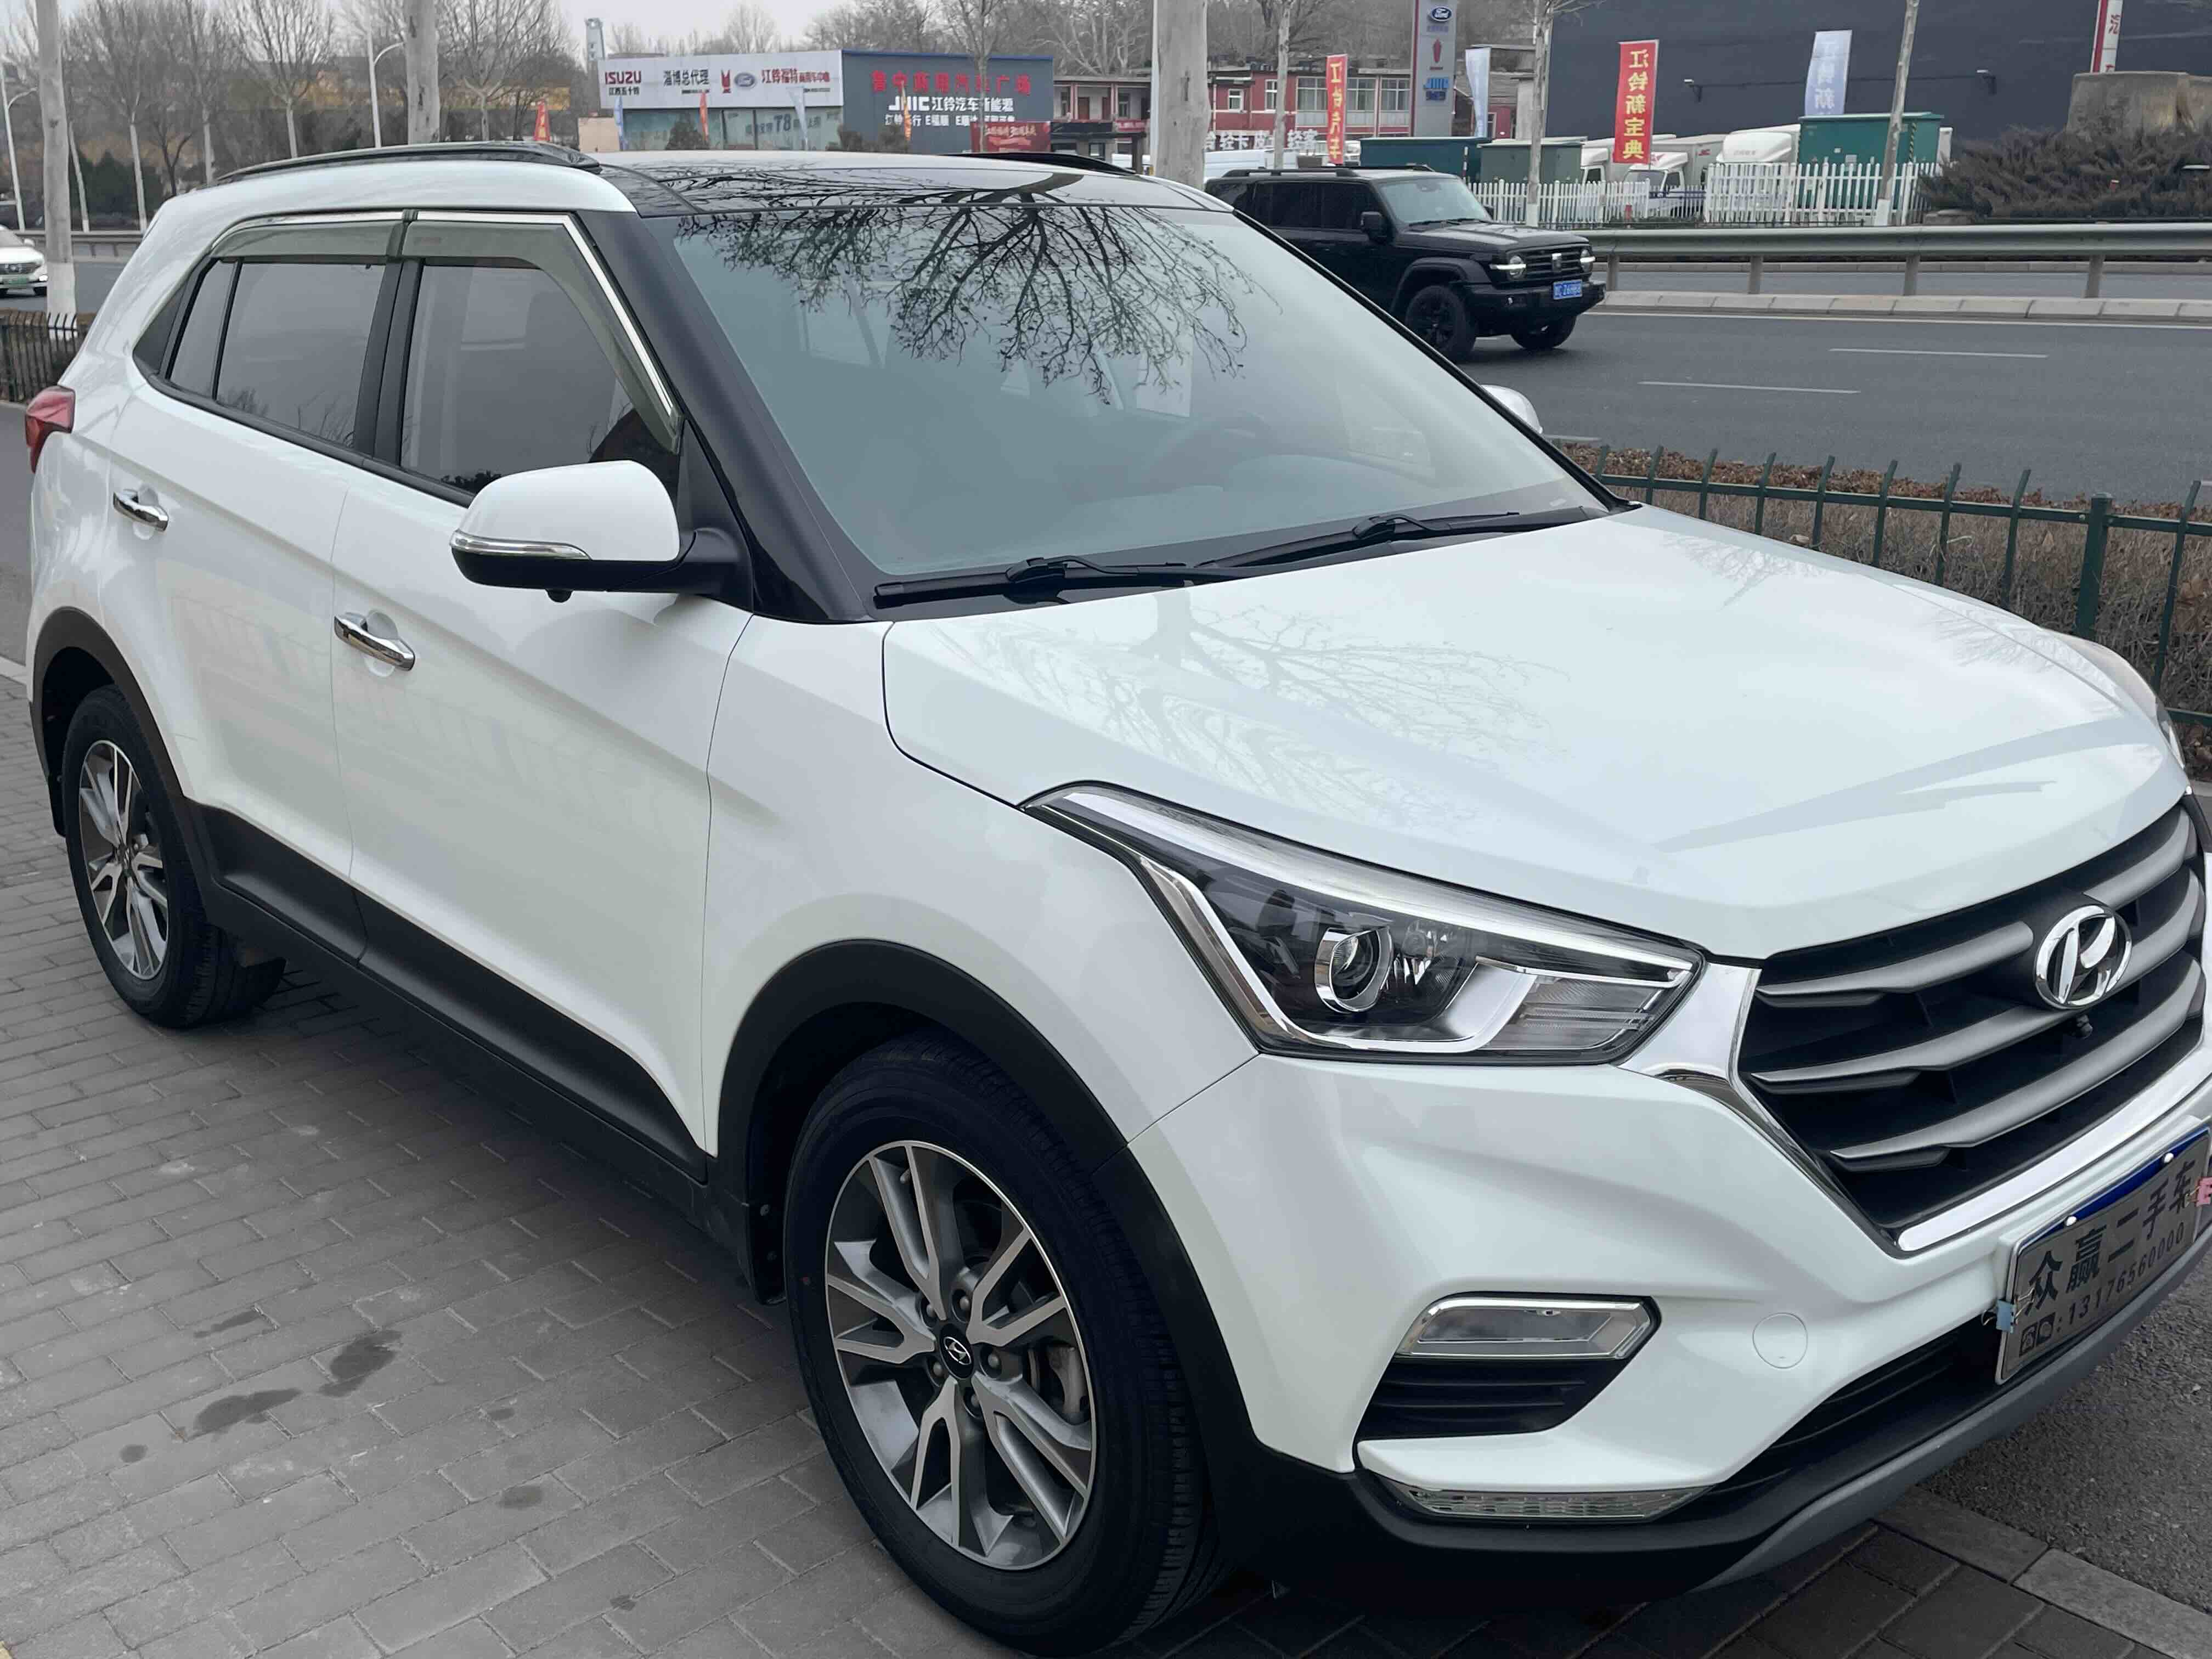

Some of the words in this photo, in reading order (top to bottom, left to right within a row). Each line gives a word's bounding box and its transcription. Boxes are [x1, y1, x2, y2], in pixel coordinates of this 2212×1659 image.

[605, 70, 641, 84] ISUZU
[2025, 1161, 2194, 1315] 众赢二手车
